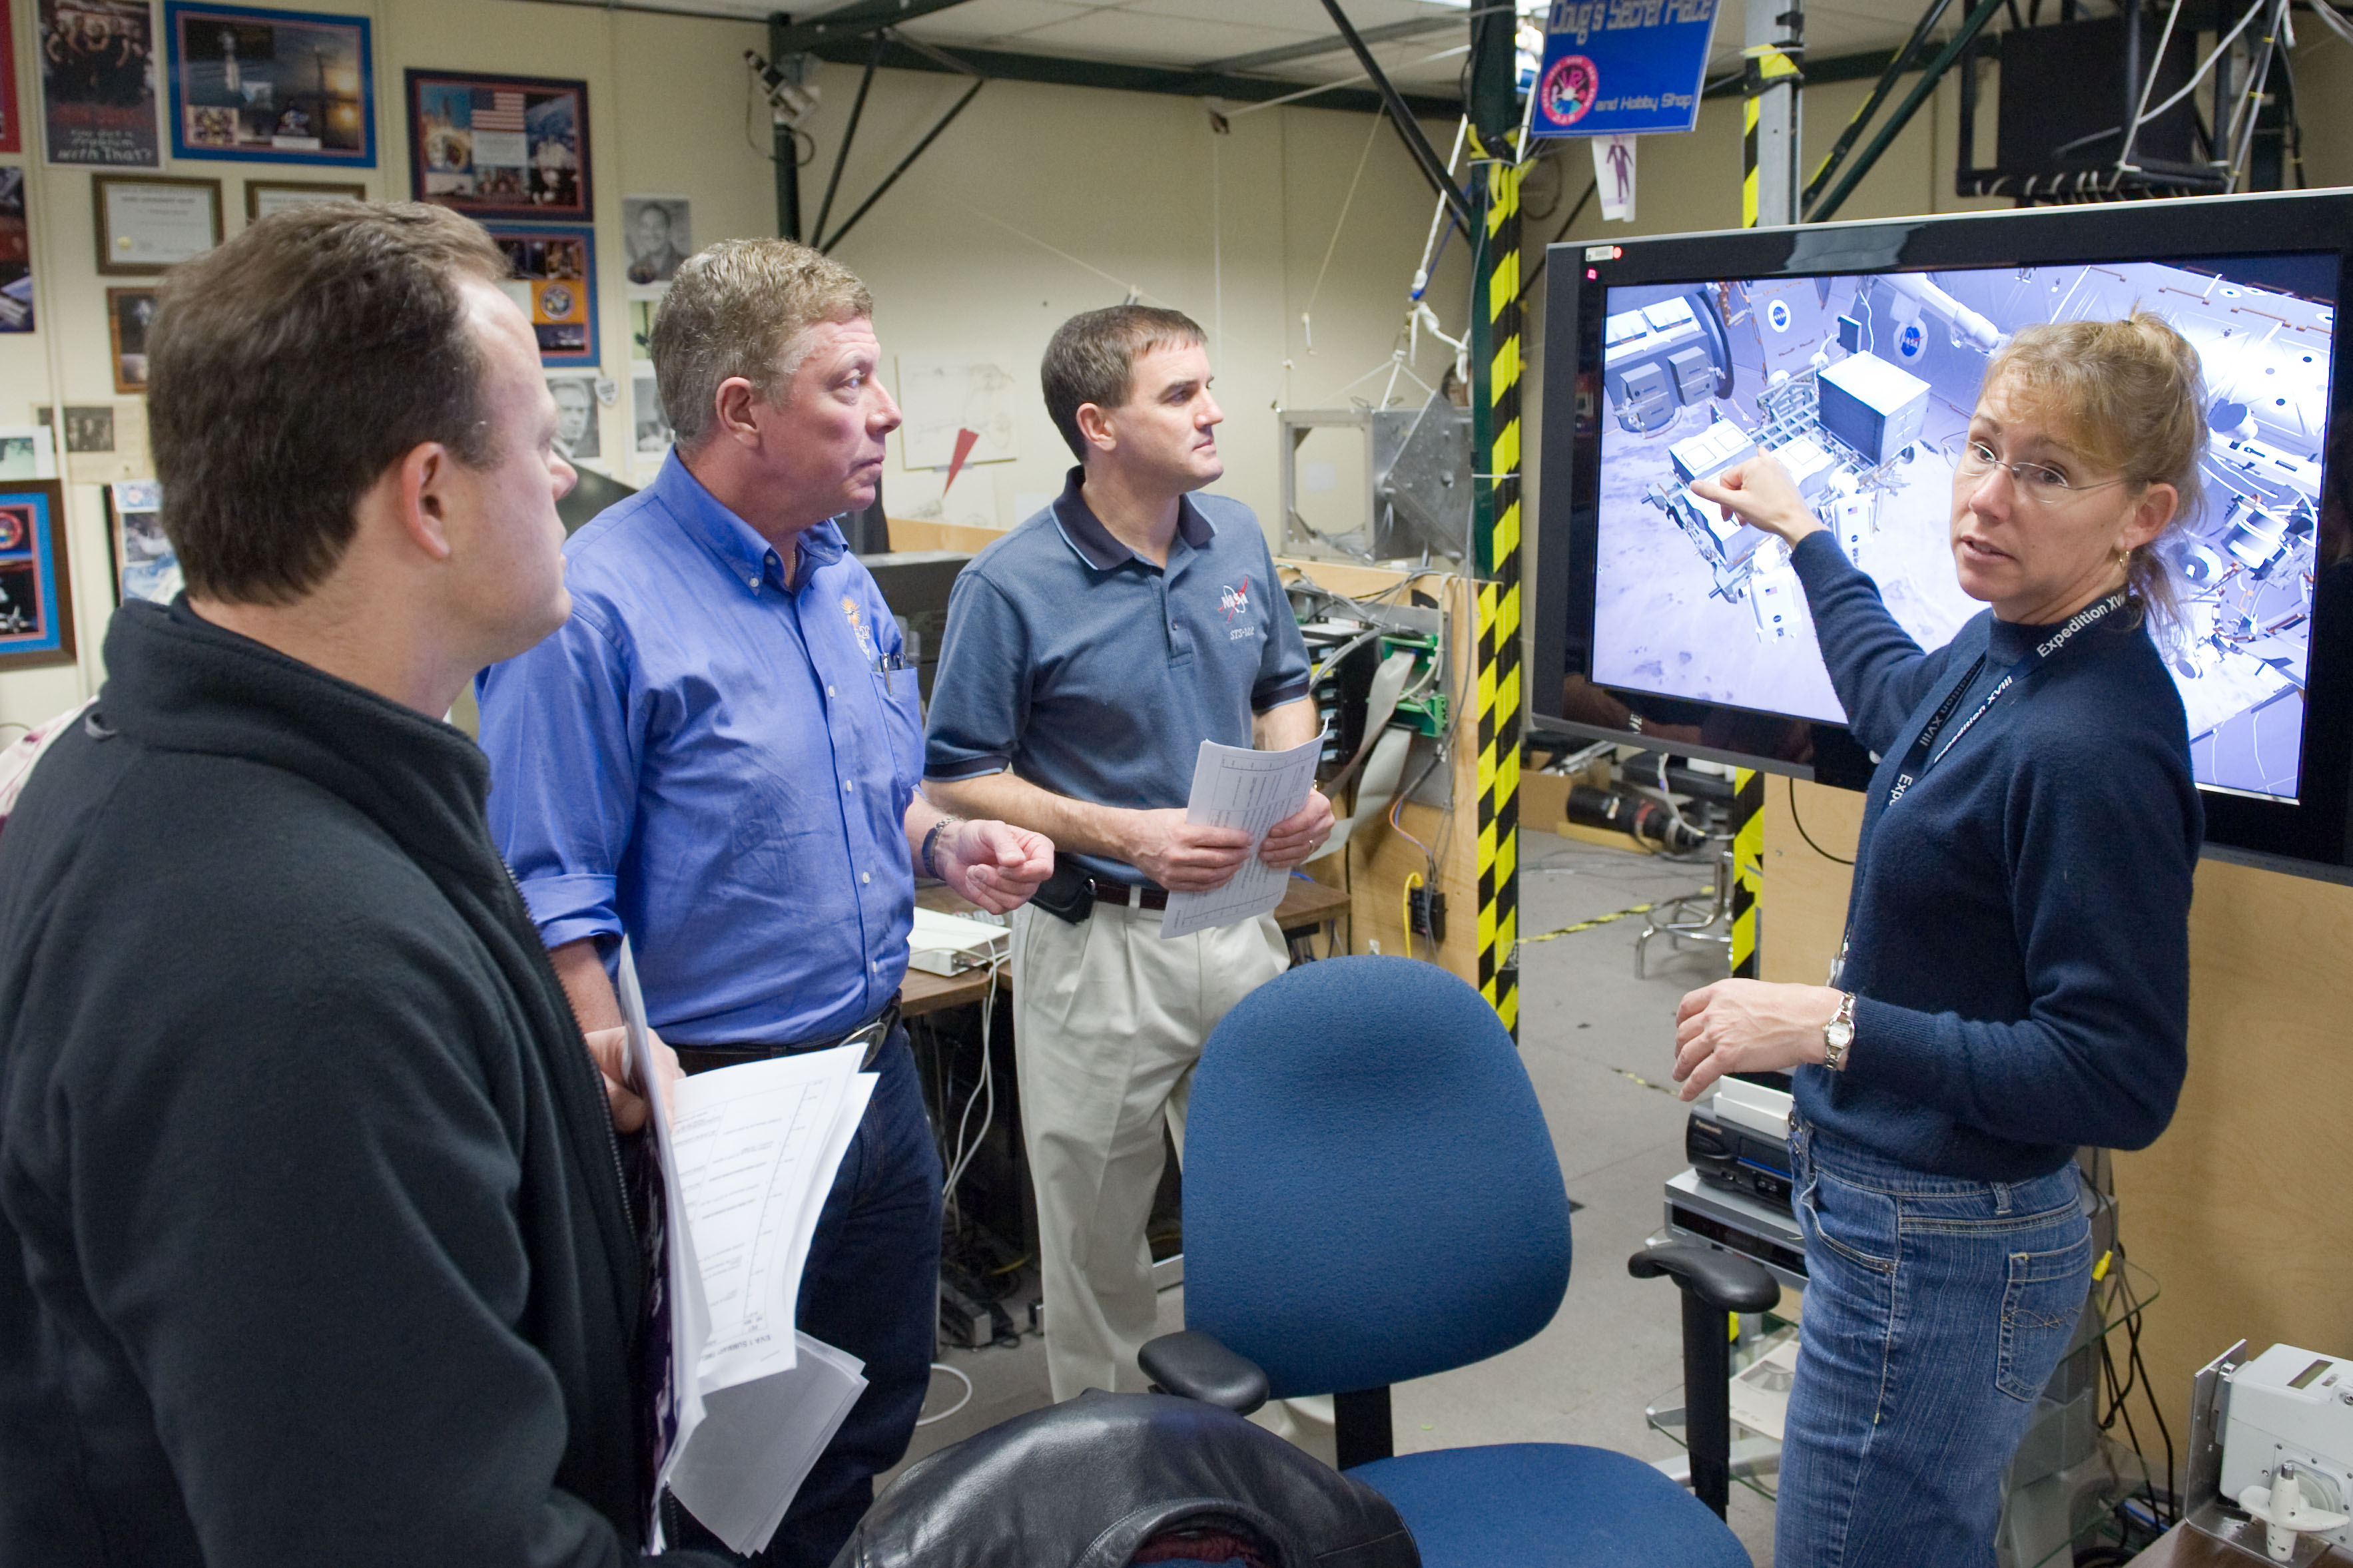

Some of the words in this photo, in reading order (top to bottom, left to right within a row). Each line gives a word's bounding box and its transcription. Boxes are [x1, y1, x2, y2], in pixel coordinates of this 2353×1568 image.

[1606, 0, 1665, 31] Secret
[1595, 97, 1618, 112] and
[1620, 95, 1658, 112] Hobby
[1661, 93, 1693, 109] Shop
[2036, 604, 2109, 658] Expedition
[1919, 715, 1943, 746] XVIII
[1934, 704, 1986, 764] Expedition
[1987, 675, 2013, 705] XVIII
